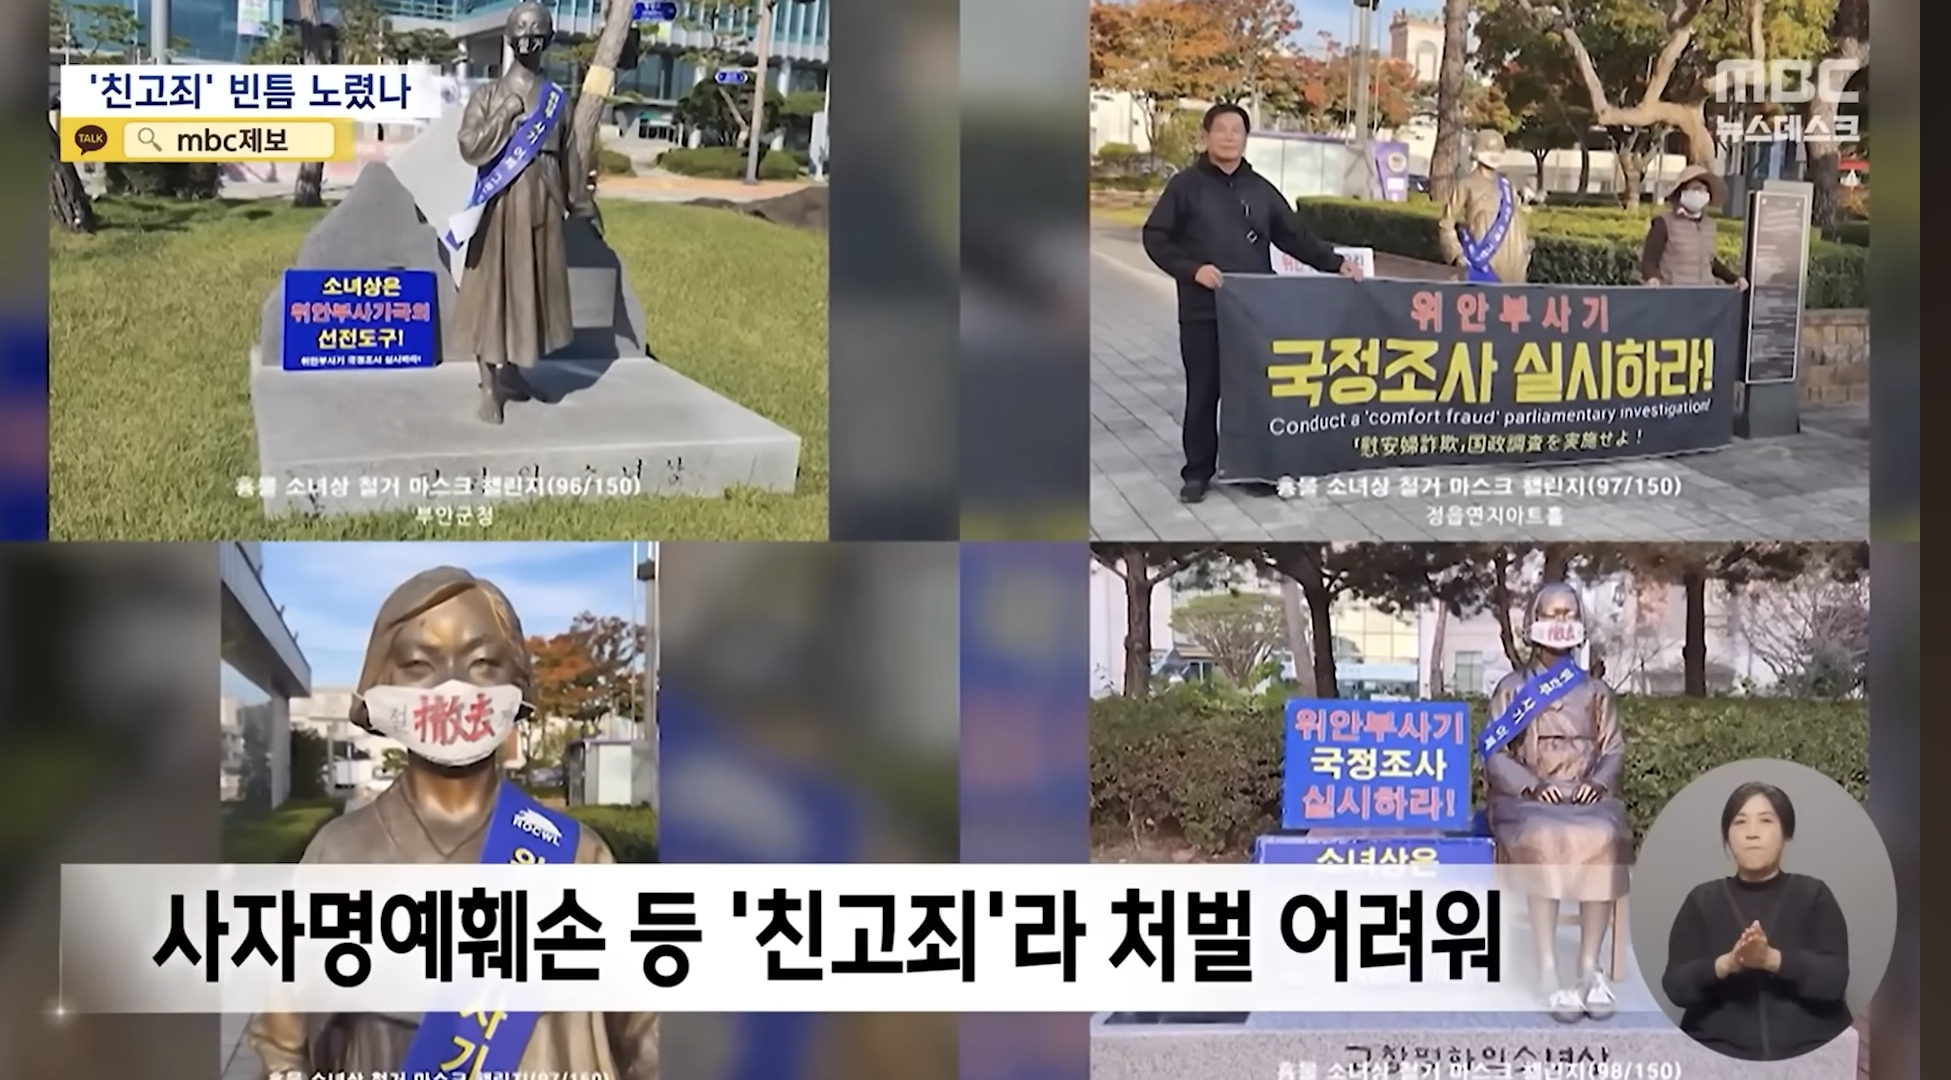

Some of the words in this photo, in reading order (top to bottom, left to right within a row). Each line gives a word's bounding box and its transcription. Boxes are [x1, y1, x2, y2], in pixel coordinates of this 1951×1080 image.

[322, 276, 402, 297] 소녀상은
[317, 328, 404, 349] 선전도구!
[1266, 338, 1499, 408] 국정조사
[1513, 337, 1714, 403] 실시하라!
[1269, 412, 1346, 436] Conduct
[1351, 413, 1360, 427] a
[1364, 407, 1441, 425] 'comfort
[1446, 408, 1501, 425] fraud'
[1504, 407, 1616, 427] parliamentary
[413, 692, 496, 746] 撤去
[1295, 708, 1465, 744] 위안부사기
[1310, 747, 1447, 781] 국정조사
[1302, 785, 1456, 820] 실시하라!
